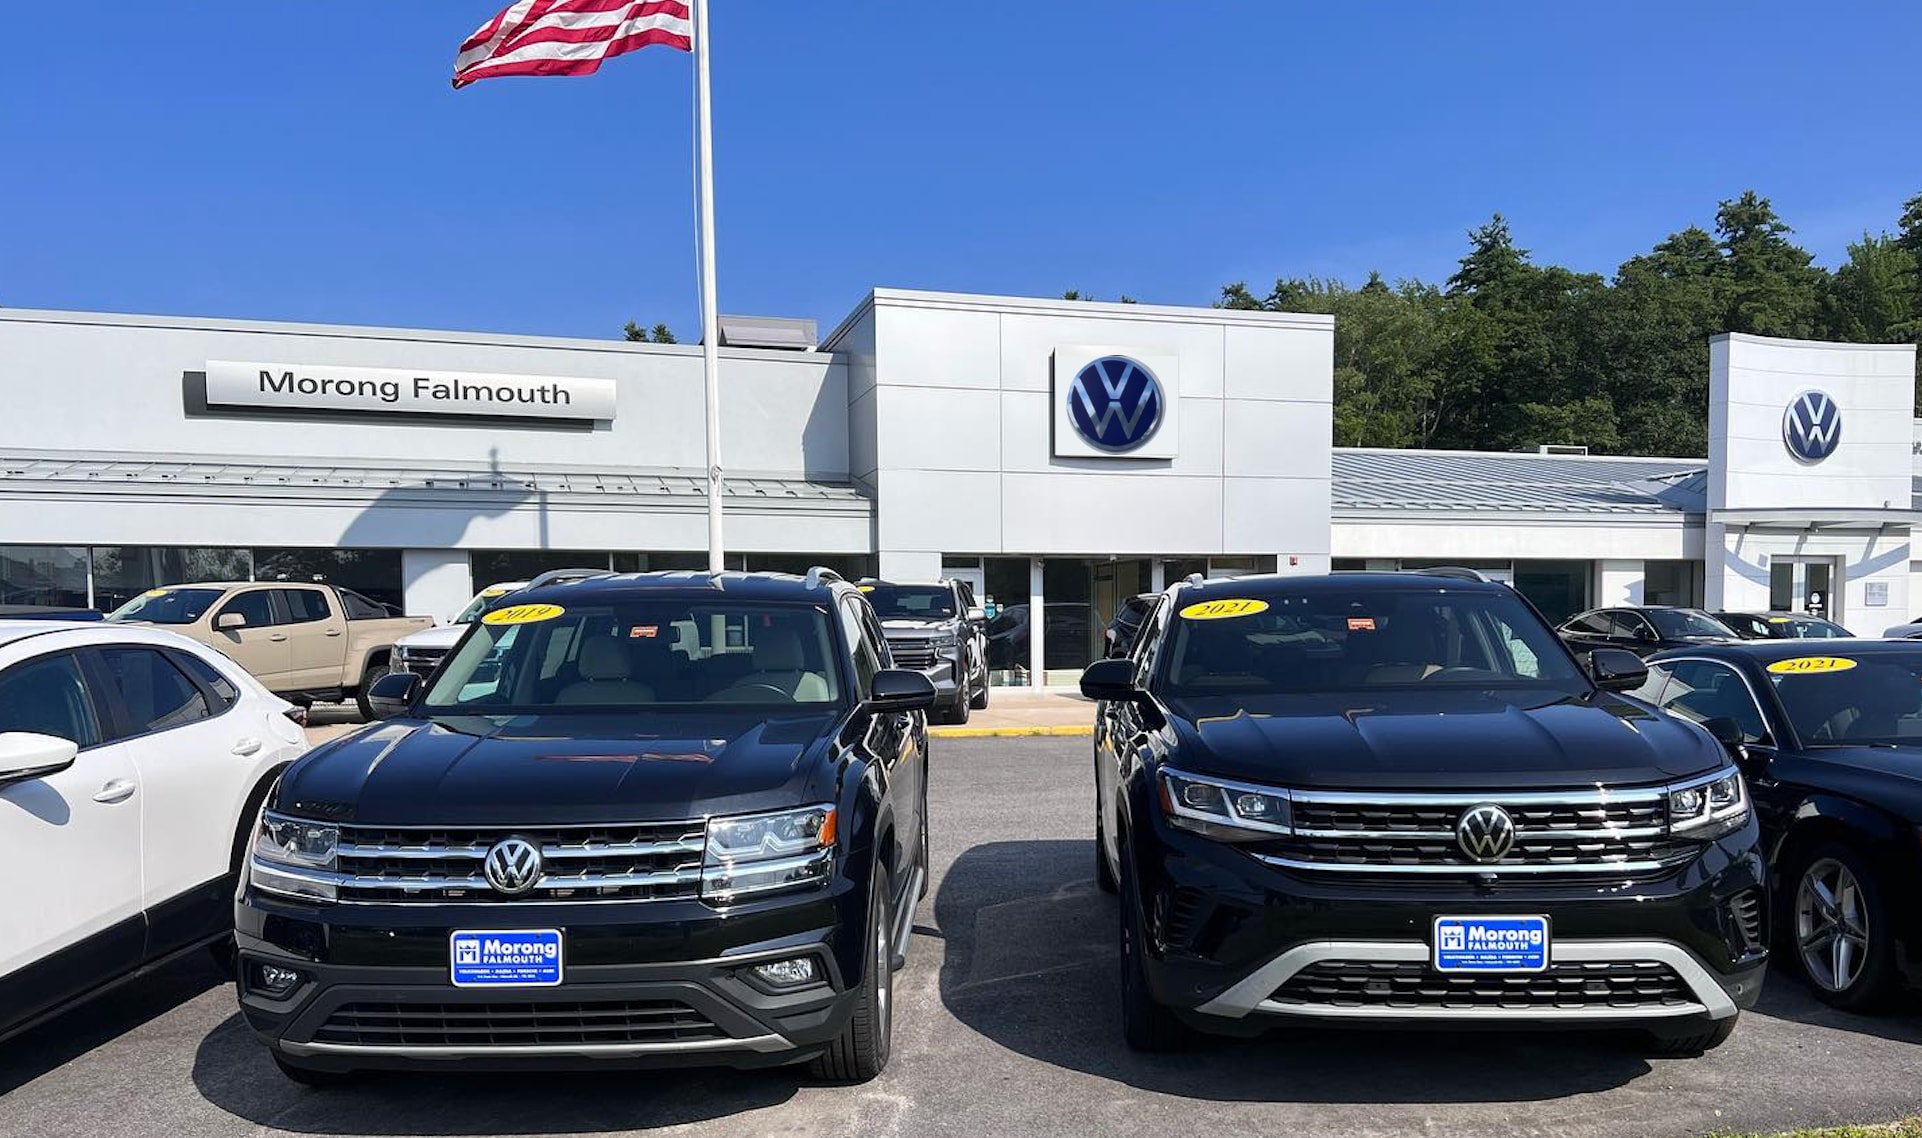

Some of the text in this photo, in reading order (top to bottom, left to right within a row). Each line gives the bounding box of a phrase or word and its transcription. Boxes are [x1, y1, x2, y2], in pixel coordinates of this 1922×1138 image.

[258, 370, 571, 405] Morong Falmouth
[493, 606, 552, 621] 2019
[1195, 601, 1251, 615] 2021
[1785, 659, 1836, 671] 2021
[1467, 926, 1542, 945] Morong
[483, 939, 557, 959] Morong
[1467, 941, 1529, 951] FALMOUTH
[483, 955, 543, 964] FALMOUTH
